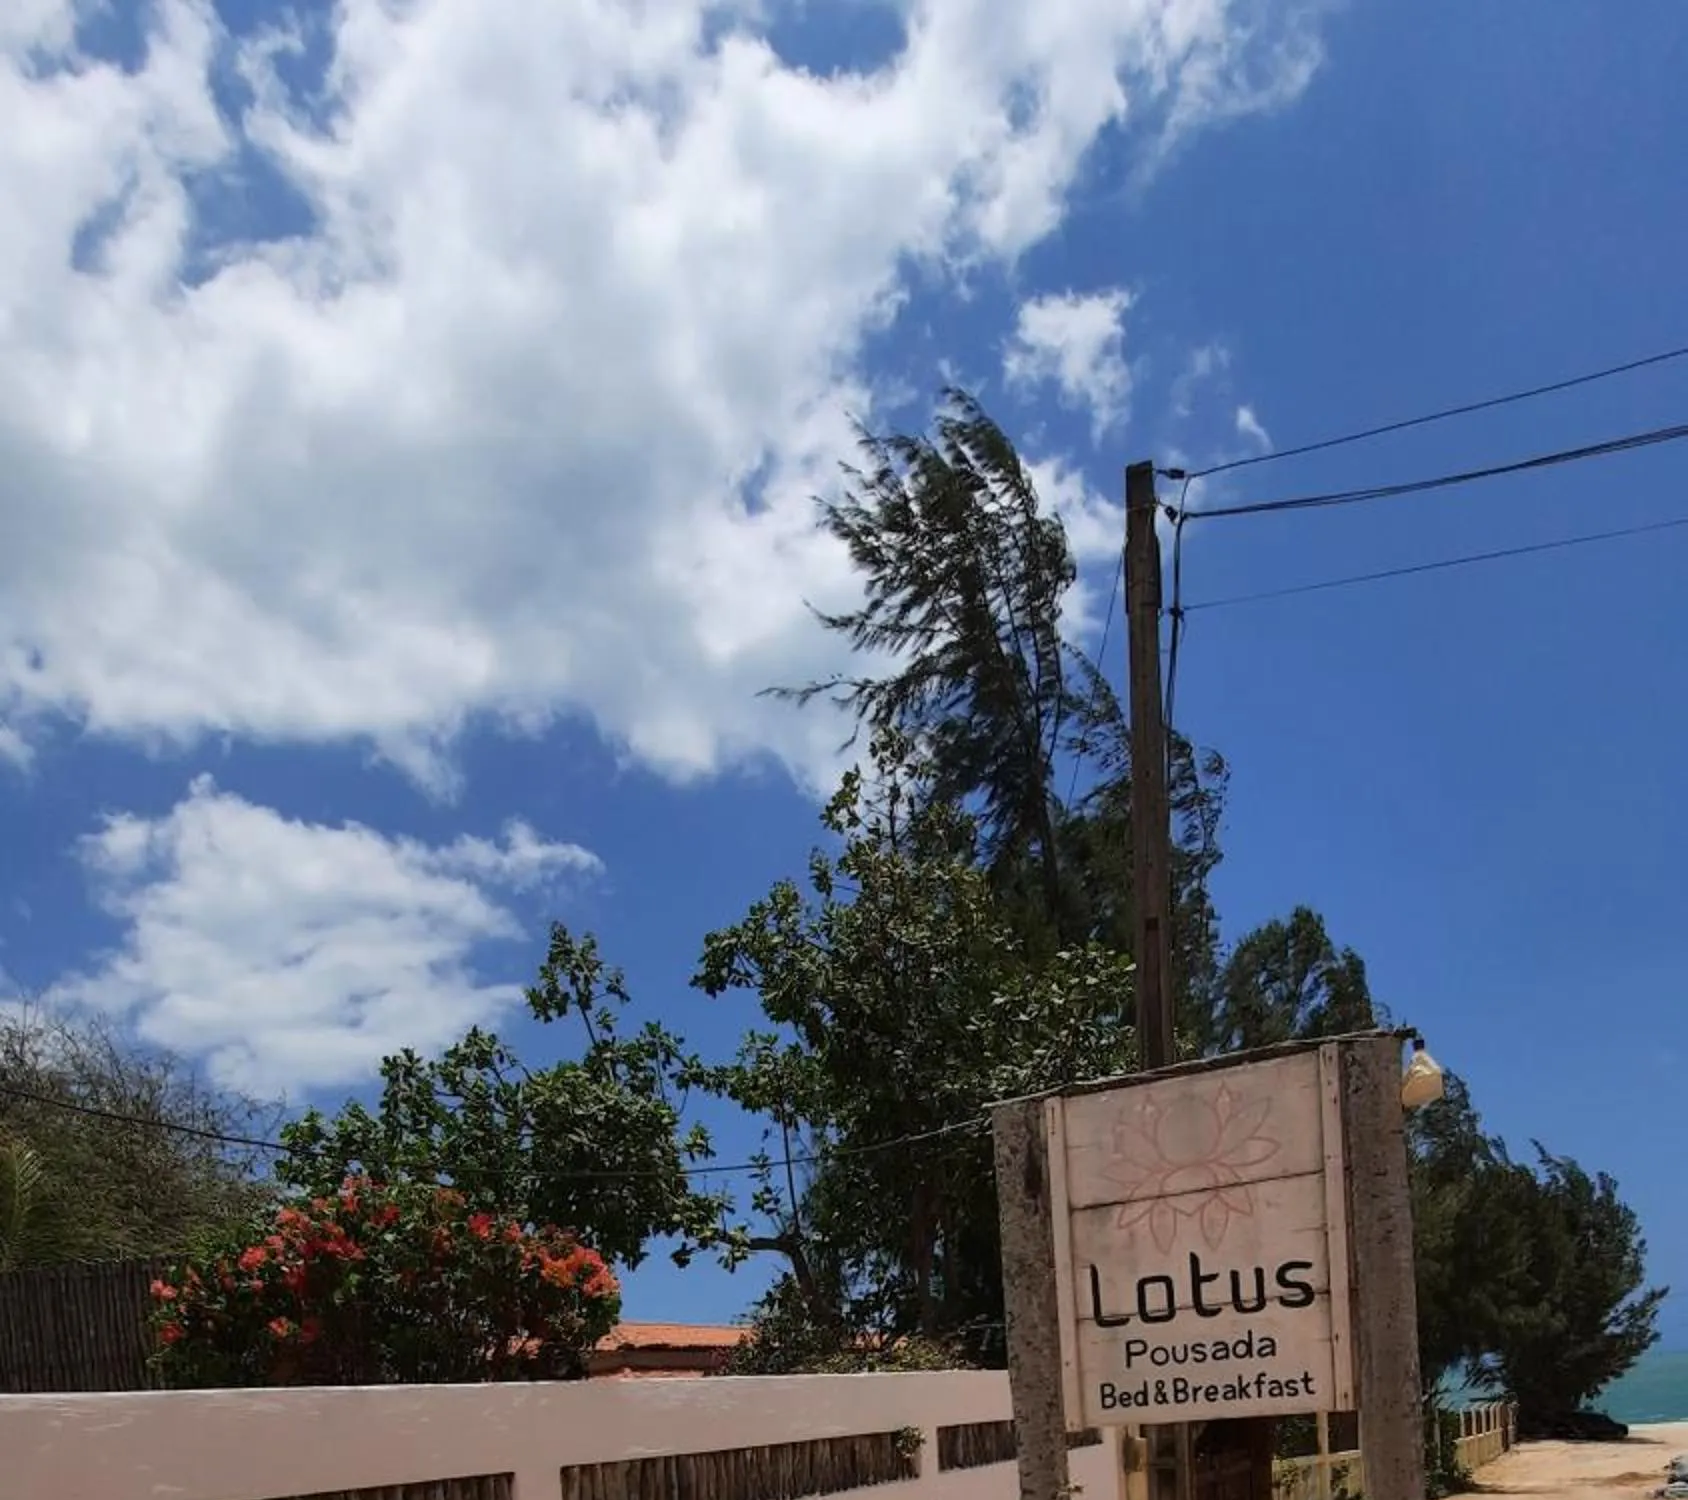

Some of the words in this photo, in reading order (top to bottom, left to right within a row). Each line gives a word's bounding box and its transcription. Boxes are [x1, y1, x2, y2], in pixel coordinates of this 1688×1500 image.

[1090, 1251, 1315, 1328] Lotus
[1125, 1329, 1277, 1369] Pousada
[1100, 1371, 1316, 1409] Bed&Breakfast
